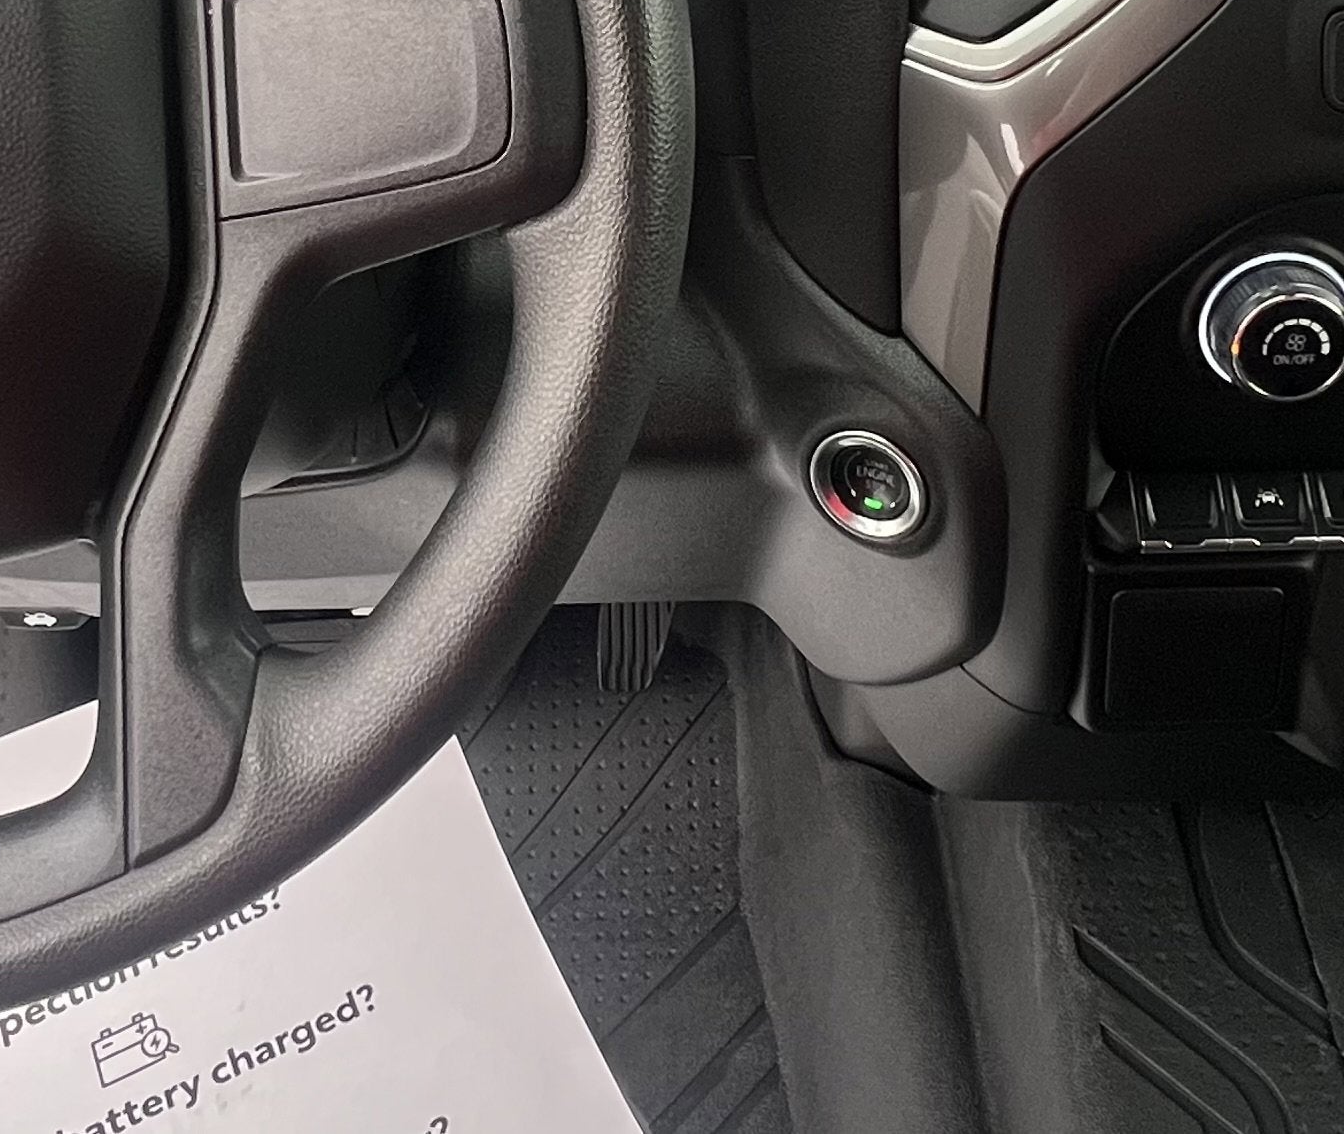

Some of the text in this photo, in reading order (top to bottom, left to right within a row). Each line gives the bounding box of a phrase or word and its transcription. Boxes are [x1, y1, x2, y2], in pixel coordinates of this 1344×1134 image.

[1273, 354, 1316, 365] ON/OFF
[56, 984, 375, 1134] attery charged?
